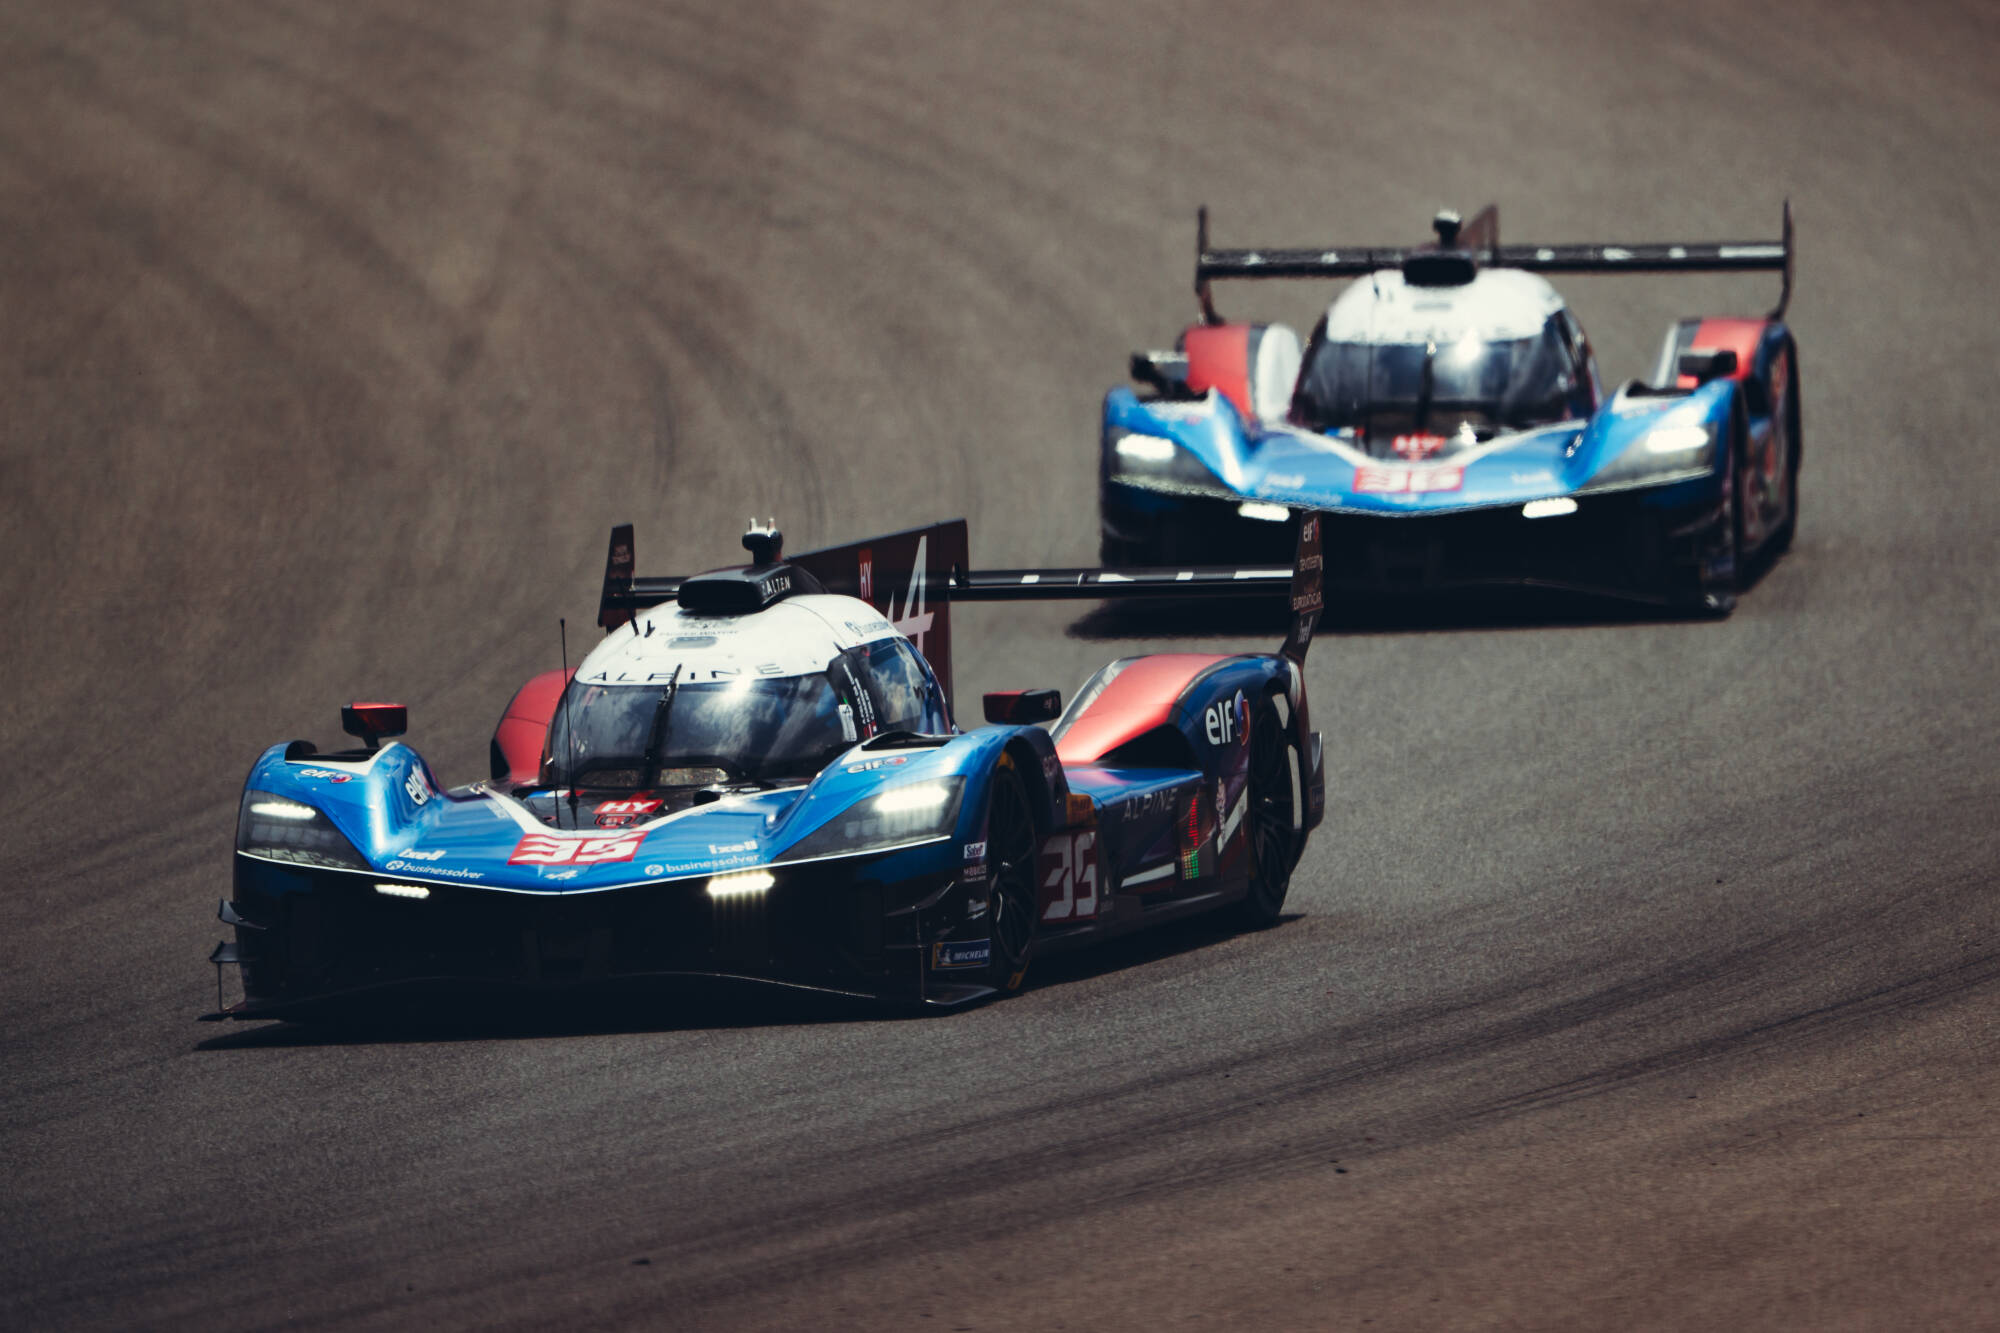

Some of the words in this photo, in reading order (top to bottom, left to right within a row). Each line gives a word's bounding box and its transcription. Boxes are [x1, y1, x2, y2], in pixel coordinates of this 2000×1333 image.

[1302, 522, 1313, 543] elf
[859, 562, 872, 599] HY
[587, 662, 785, 683] ALPINE
[1205, 699, 1234, 746] elf
[300, 768, 336, 779] elf
[847, 760, 886, 774] elf
[601, 802, 657, 812] HY
[1122, 787, 1178, 822] ALPINE
[511, 832, 646, 863] 35
[403, 862, 485, 879] businessolver
[666, 854, 761, 873] businessolver
[1042, 831, 1098, 920] 35
[953, 948, 989, 961] MICHELIN
